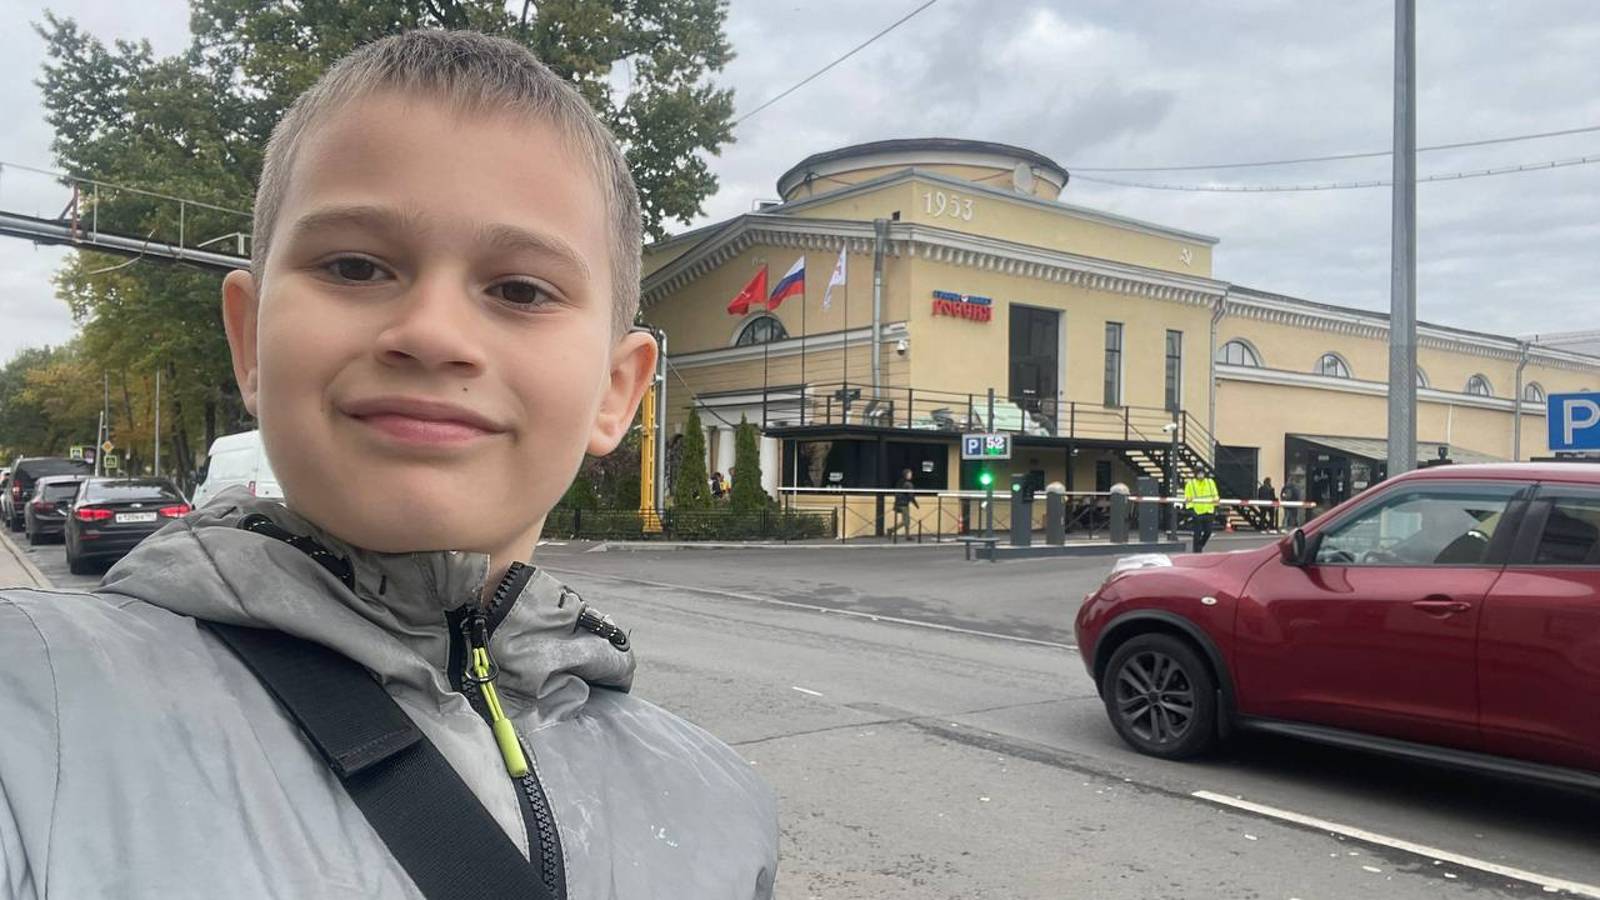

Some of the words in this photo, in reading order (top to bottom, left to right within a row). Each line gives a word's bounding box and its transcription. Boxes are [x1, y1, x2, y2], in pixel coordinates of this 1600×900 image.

[922, 191, 974, 221] 1953
[1563, 399, 1600, 445] P
[968, 439, 979, 454] P
